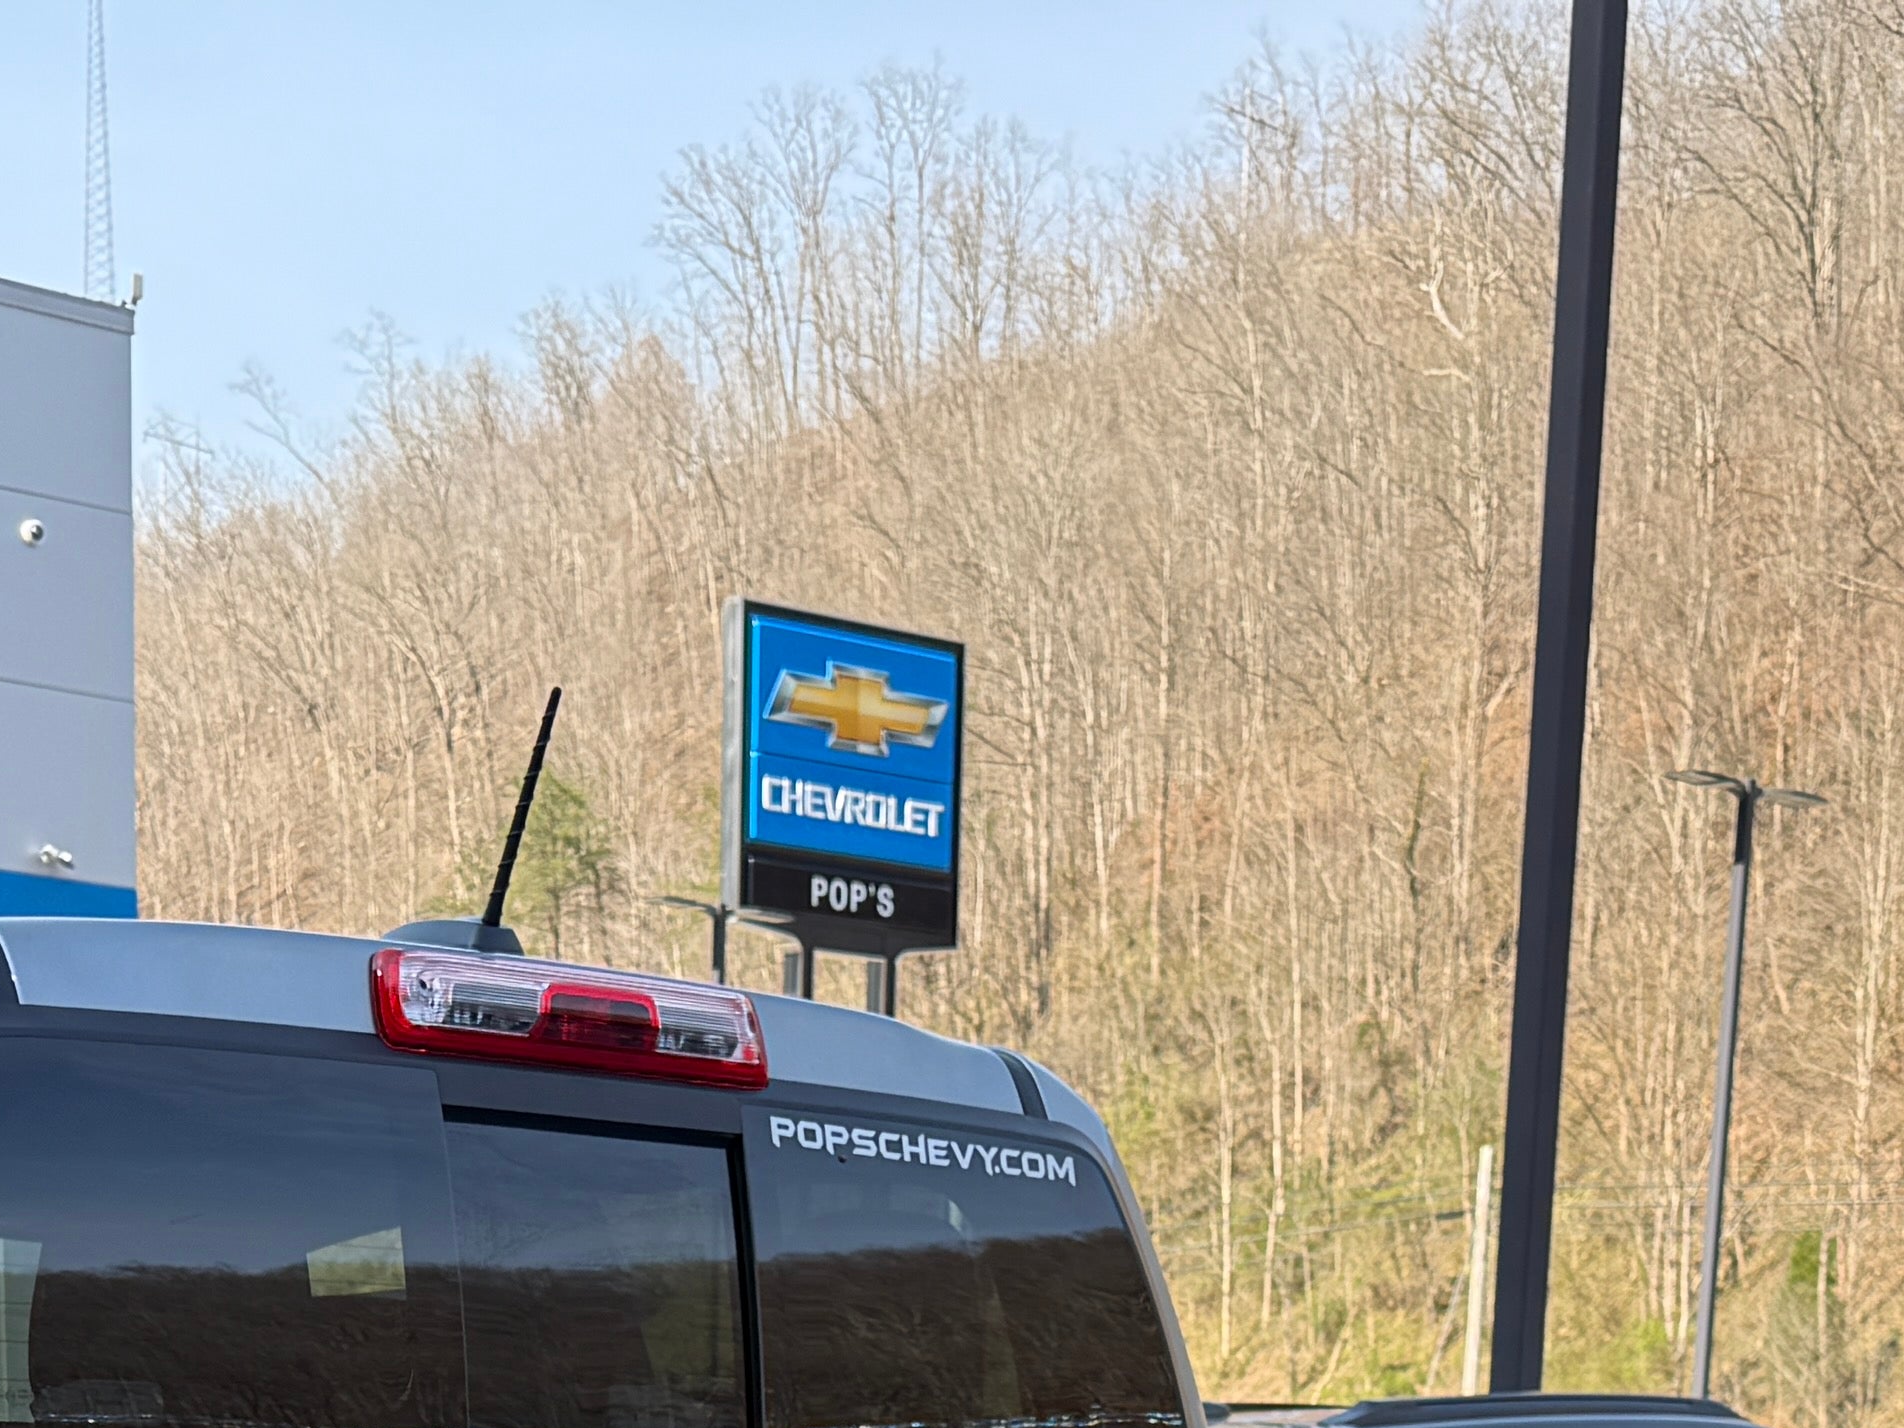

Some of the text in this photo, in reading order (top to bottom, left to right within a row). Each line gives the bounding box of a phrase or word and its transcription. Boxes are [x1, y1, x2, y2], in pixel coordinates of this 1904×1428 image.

[760, 773, 945, 838] CHEVROLET
[809, 874, 895, 919] POP'S
[768, 1114, 1078, 1188] POPSCHEVY.COM
